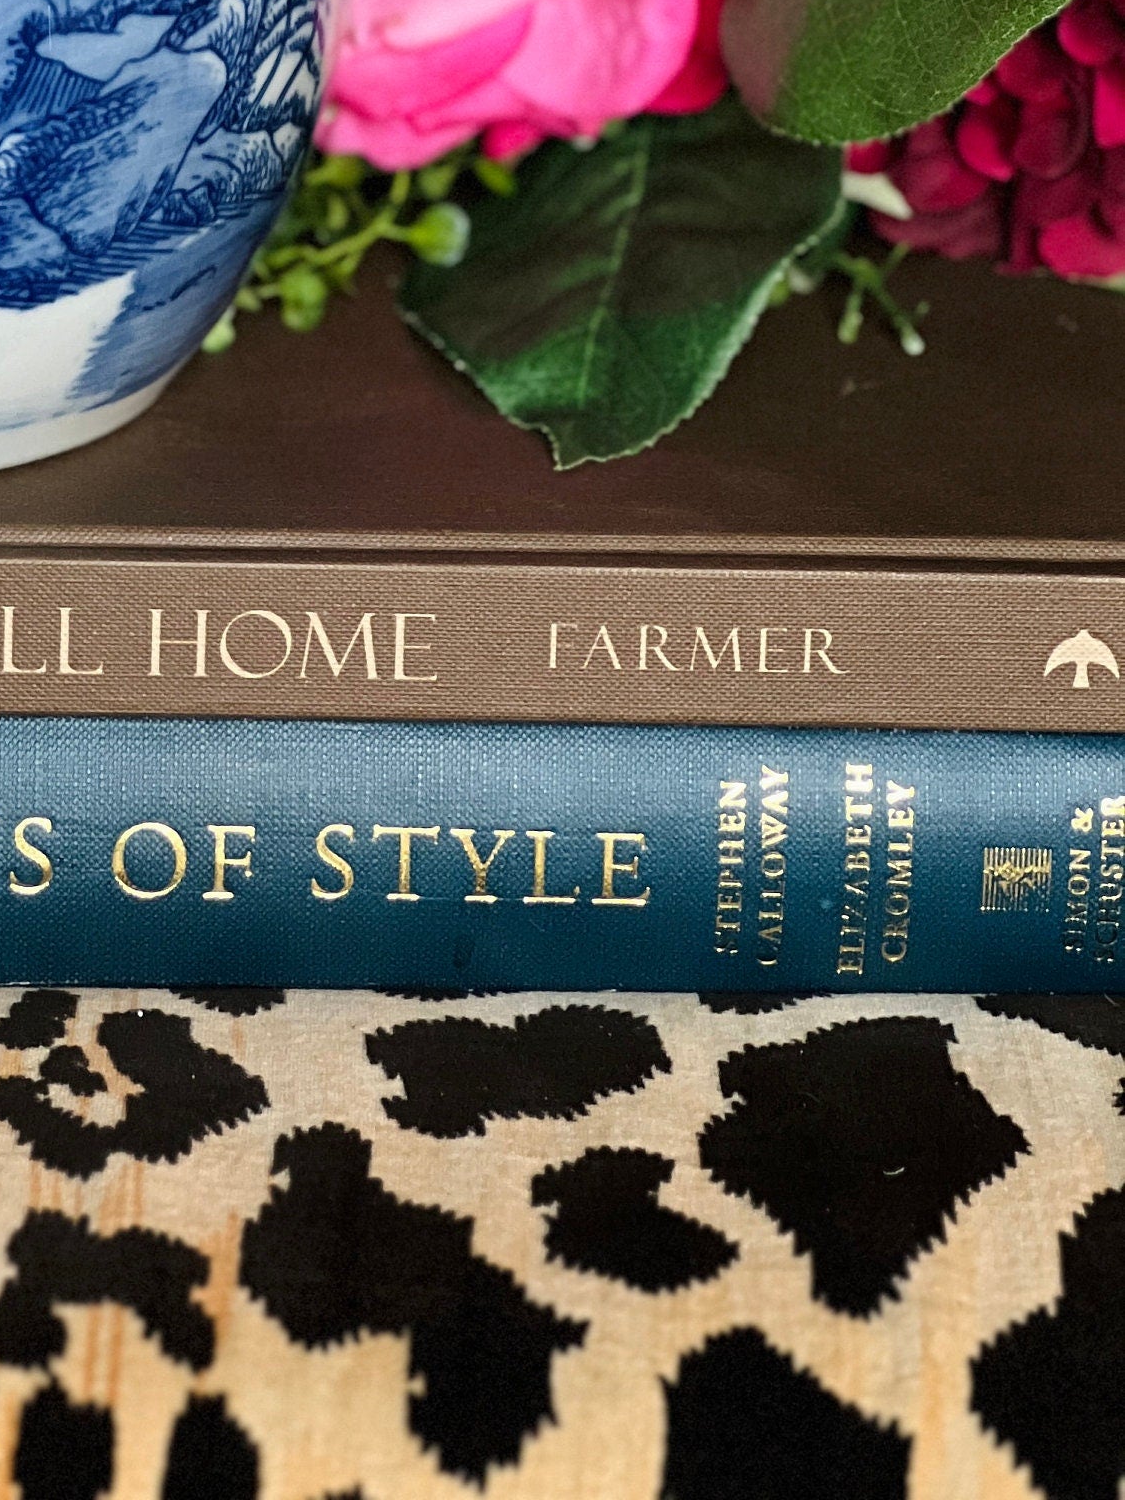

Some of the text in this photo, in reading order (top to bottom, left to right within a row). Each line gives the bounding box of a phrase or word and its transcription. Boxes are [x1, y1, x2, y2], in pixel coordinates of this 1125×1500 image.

[147, 607, 440, 682] HOME
[548, 622, 851, 675] FARMER
[1070, 806, 1094, 833] &
[112, 821, 257, 900] OF
[310, 822, 651, 907] STYLE
[713, 779, 747, 955] STEPHEN
[836, 761, 874, 976] ELIZABETH
[881, 779, 916, 963] CROMLEY
